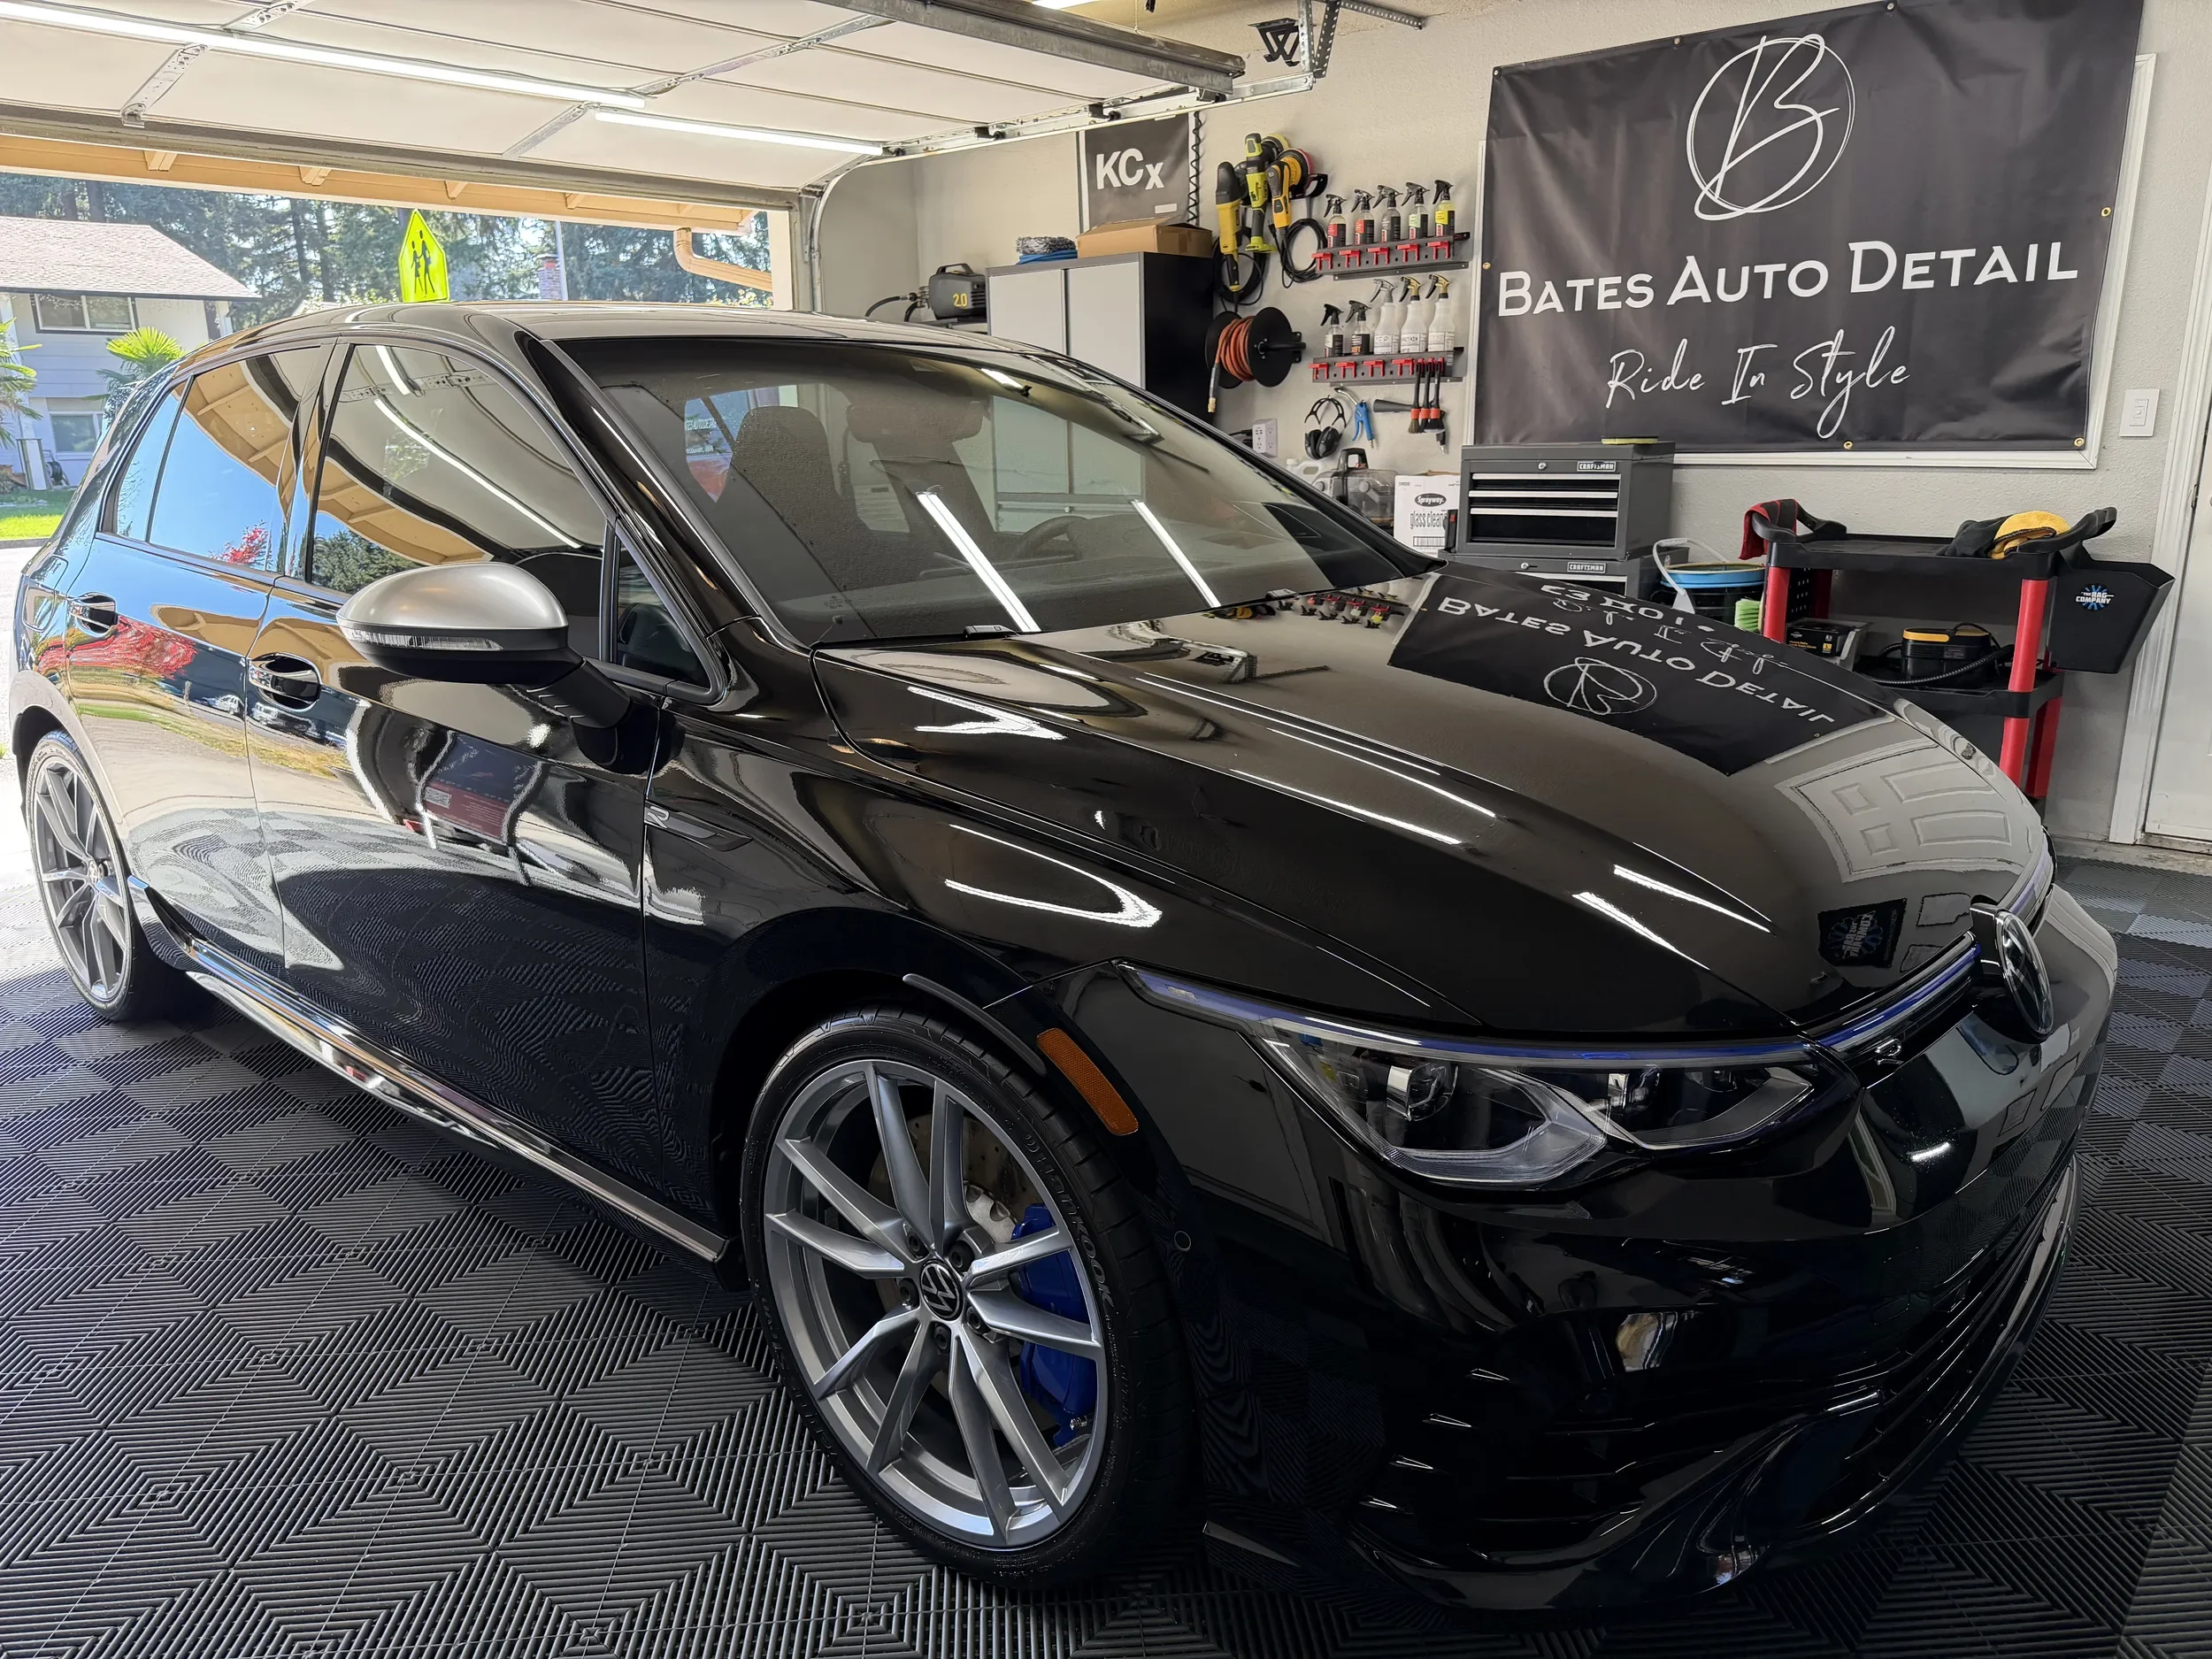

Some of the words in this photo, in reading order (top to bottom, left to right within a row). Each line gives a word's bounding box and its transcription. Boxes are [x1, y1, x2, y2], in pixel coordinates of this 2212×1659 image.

[1096, 148, 1165, 191] KCx
[1499, 271, 1655, 317] BATES
[1667, 256, 1829, 306] AUTO
[1848, 241, 2078, 294] DETAIL
[953, 293, 968, 307] 2.0
[1606, 339, 1705, 410] Ride
[1722, 343, 1778, 405] In
[1791, 326, 1910, 439] Style
[1417, 496, 1444, 505] Sprayway
[1410, 511, 1425, 529] glass
[1427, 511, 1448, 528] clean
[1568, 563, 1604, 572] CRAFTSMAN
[648, 806, 670, 829] R
